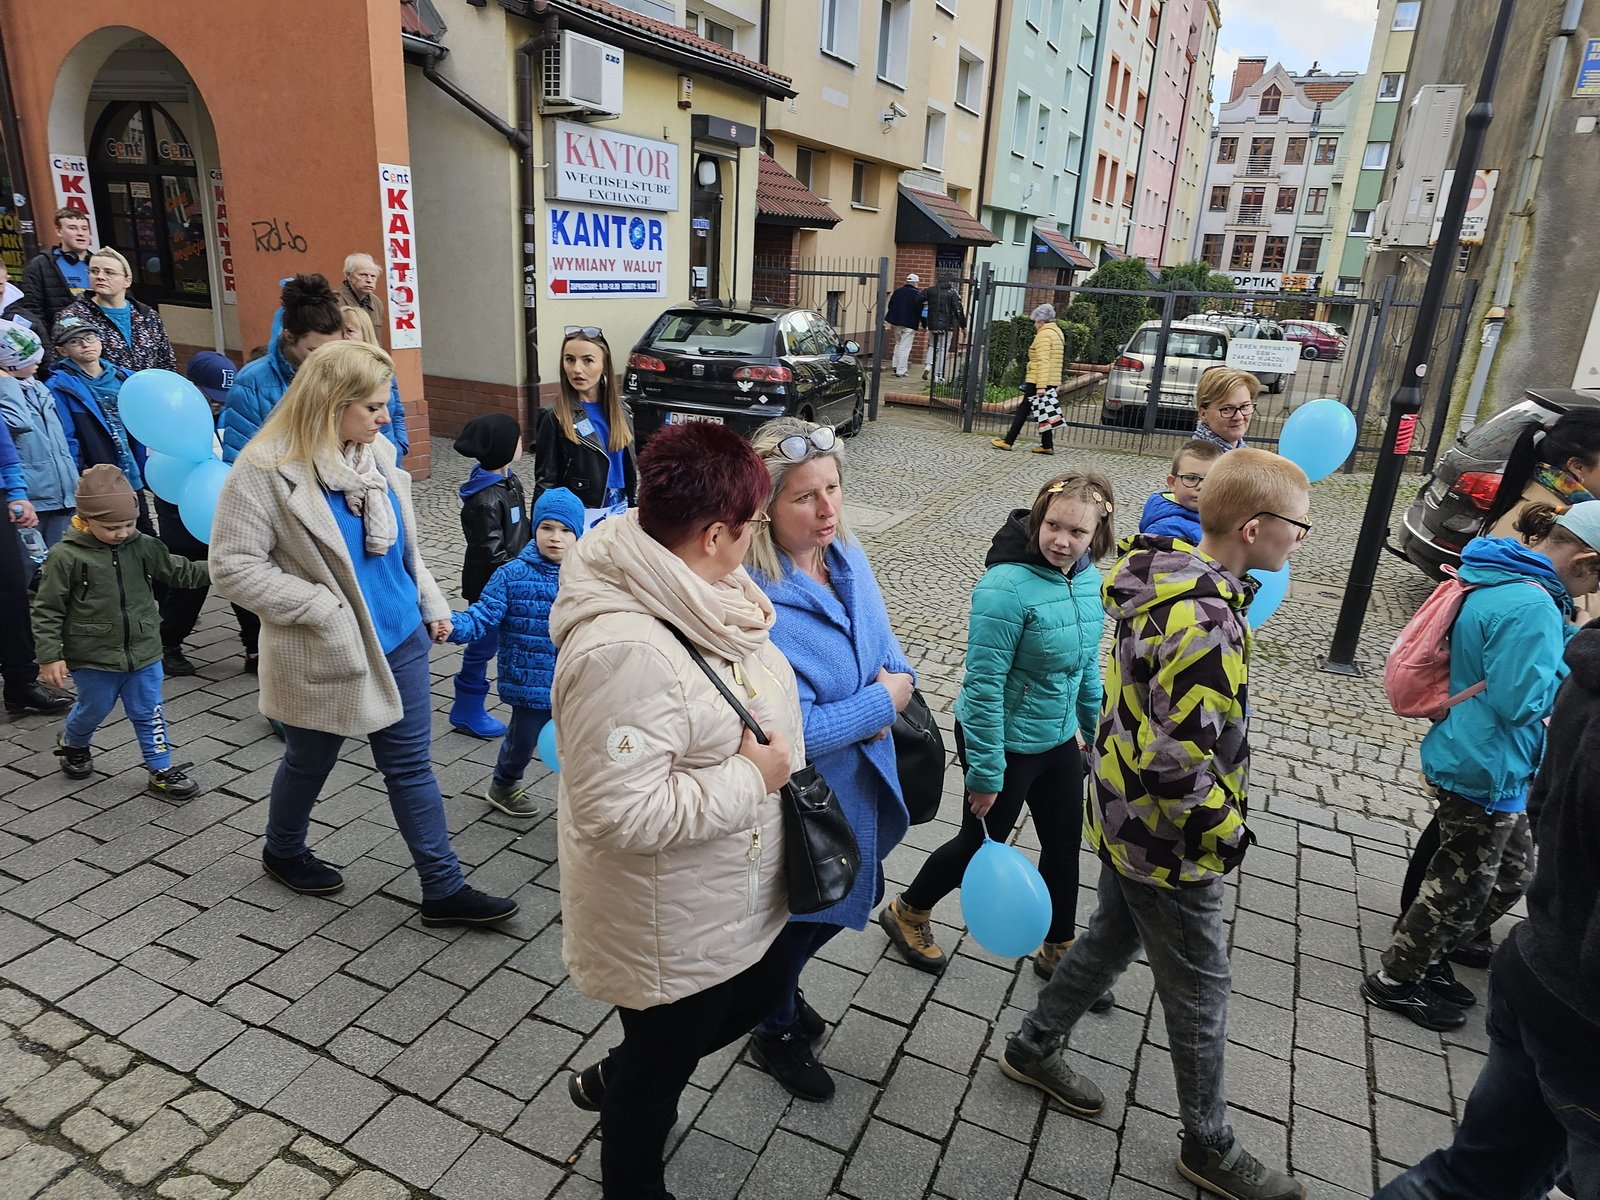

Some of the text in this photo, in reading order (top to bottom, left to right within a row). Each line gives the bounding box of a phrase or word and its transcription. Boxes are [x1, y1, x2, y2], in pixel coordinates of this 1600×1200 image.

[105, 138, 144, 157] Cent
[159, 139, 194, 158] Cen
[563, 131, 671, 180] KANTOR
[54, 159, 86, 172] Cent
[382, 170, 410, 183] Cent
[565, 171, 671, 195] WECHSELSTUBE
[589, 188, 652, 206] EXCHANGE
[551, 209, 663, 251] KANTOR
[386, 188, 417, 330] KANTOR
[552, 257, 663, 273] WYMIANY WALUT
[1233, 276, 1276, 288] OPTIK
